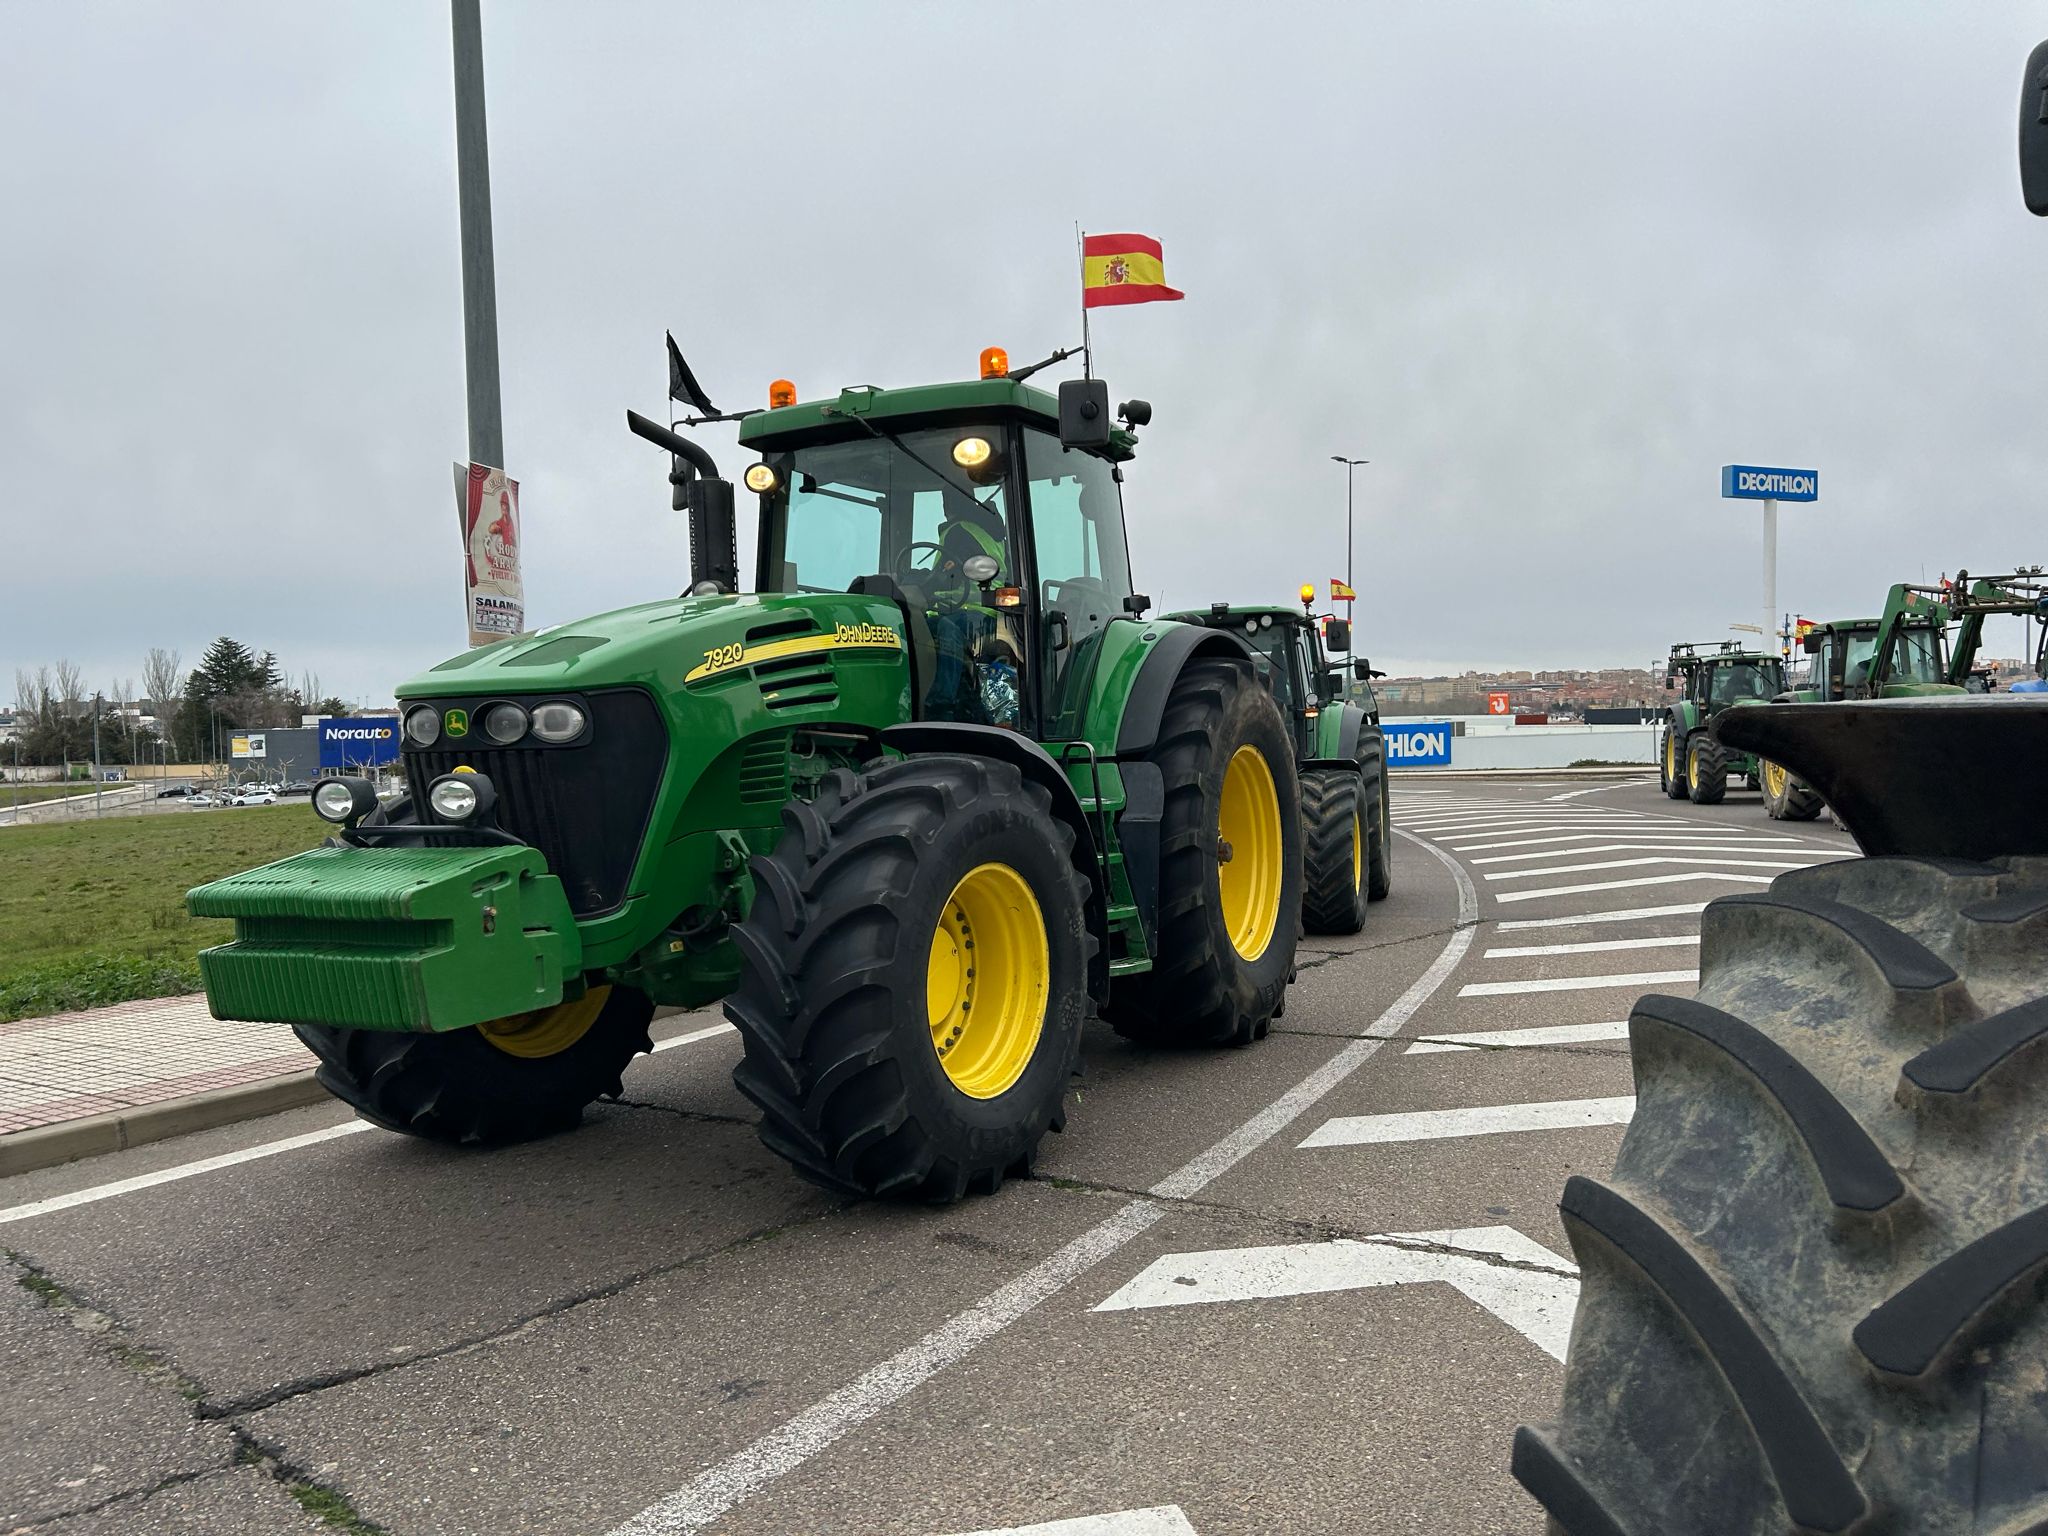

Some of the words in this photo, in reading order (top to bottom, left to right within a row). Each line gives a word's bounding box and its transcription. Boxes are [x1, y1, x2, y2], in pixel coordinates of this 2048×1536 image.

[1739, 472, 1814, 494] DECATHLON
[834, 621, 863, 643] JOHN
[862, 622, 895, 643] DEERE
[704, 642, 744, 670] 7920
[326, 728, 392, 740] Norauto
